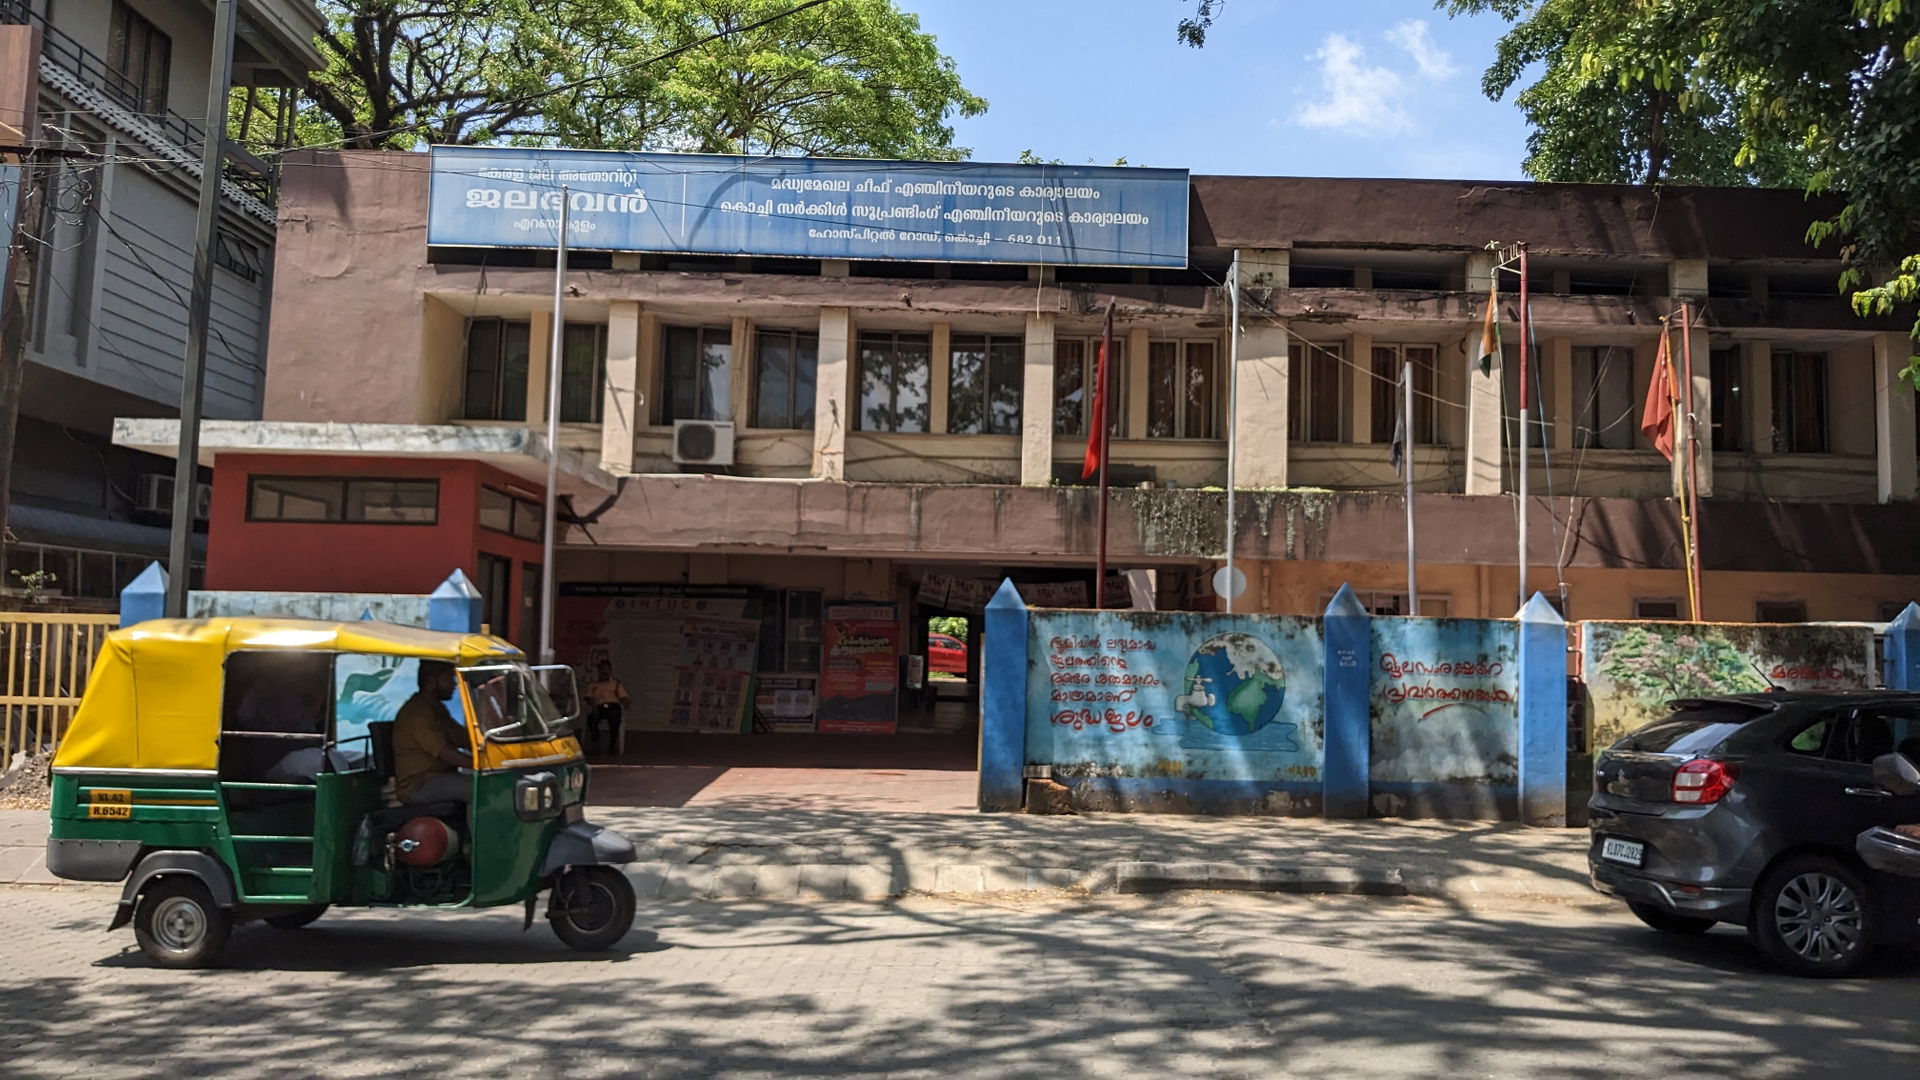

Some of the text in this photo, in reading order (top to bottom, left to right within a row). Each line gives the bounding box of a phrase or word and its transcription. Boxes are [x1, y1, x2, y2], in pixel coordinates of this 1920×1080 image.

[479, 167, 637, 188] കേരള ജല അതോറിറ്റി
[854, 177, 892, 193] ചീഫ്
[894, 180, 1014, 199] എഞ്ചിനീയറുടെ
[1019, 184, 1100, 201] കാര്യാലയം
[466, 188, 648, 214] ജലഭവൻ
[720, 200, 773, 218] കൊച്ചി
[777, 201, 847, 217] സർക്കിൾ
[944, 206, 1064, 226] എഞ്ചിനീയറുടെ
[1068, 212, 1150, 228] കാര്യാലയം
[808, 229, 895, 243] ഹോസ്പിറ്റൽ
[945, 231, 991, 246] കൊച്ചി
[1008, 234, 1033, 245] 682
[1037, 234, 1062, 245] 011
